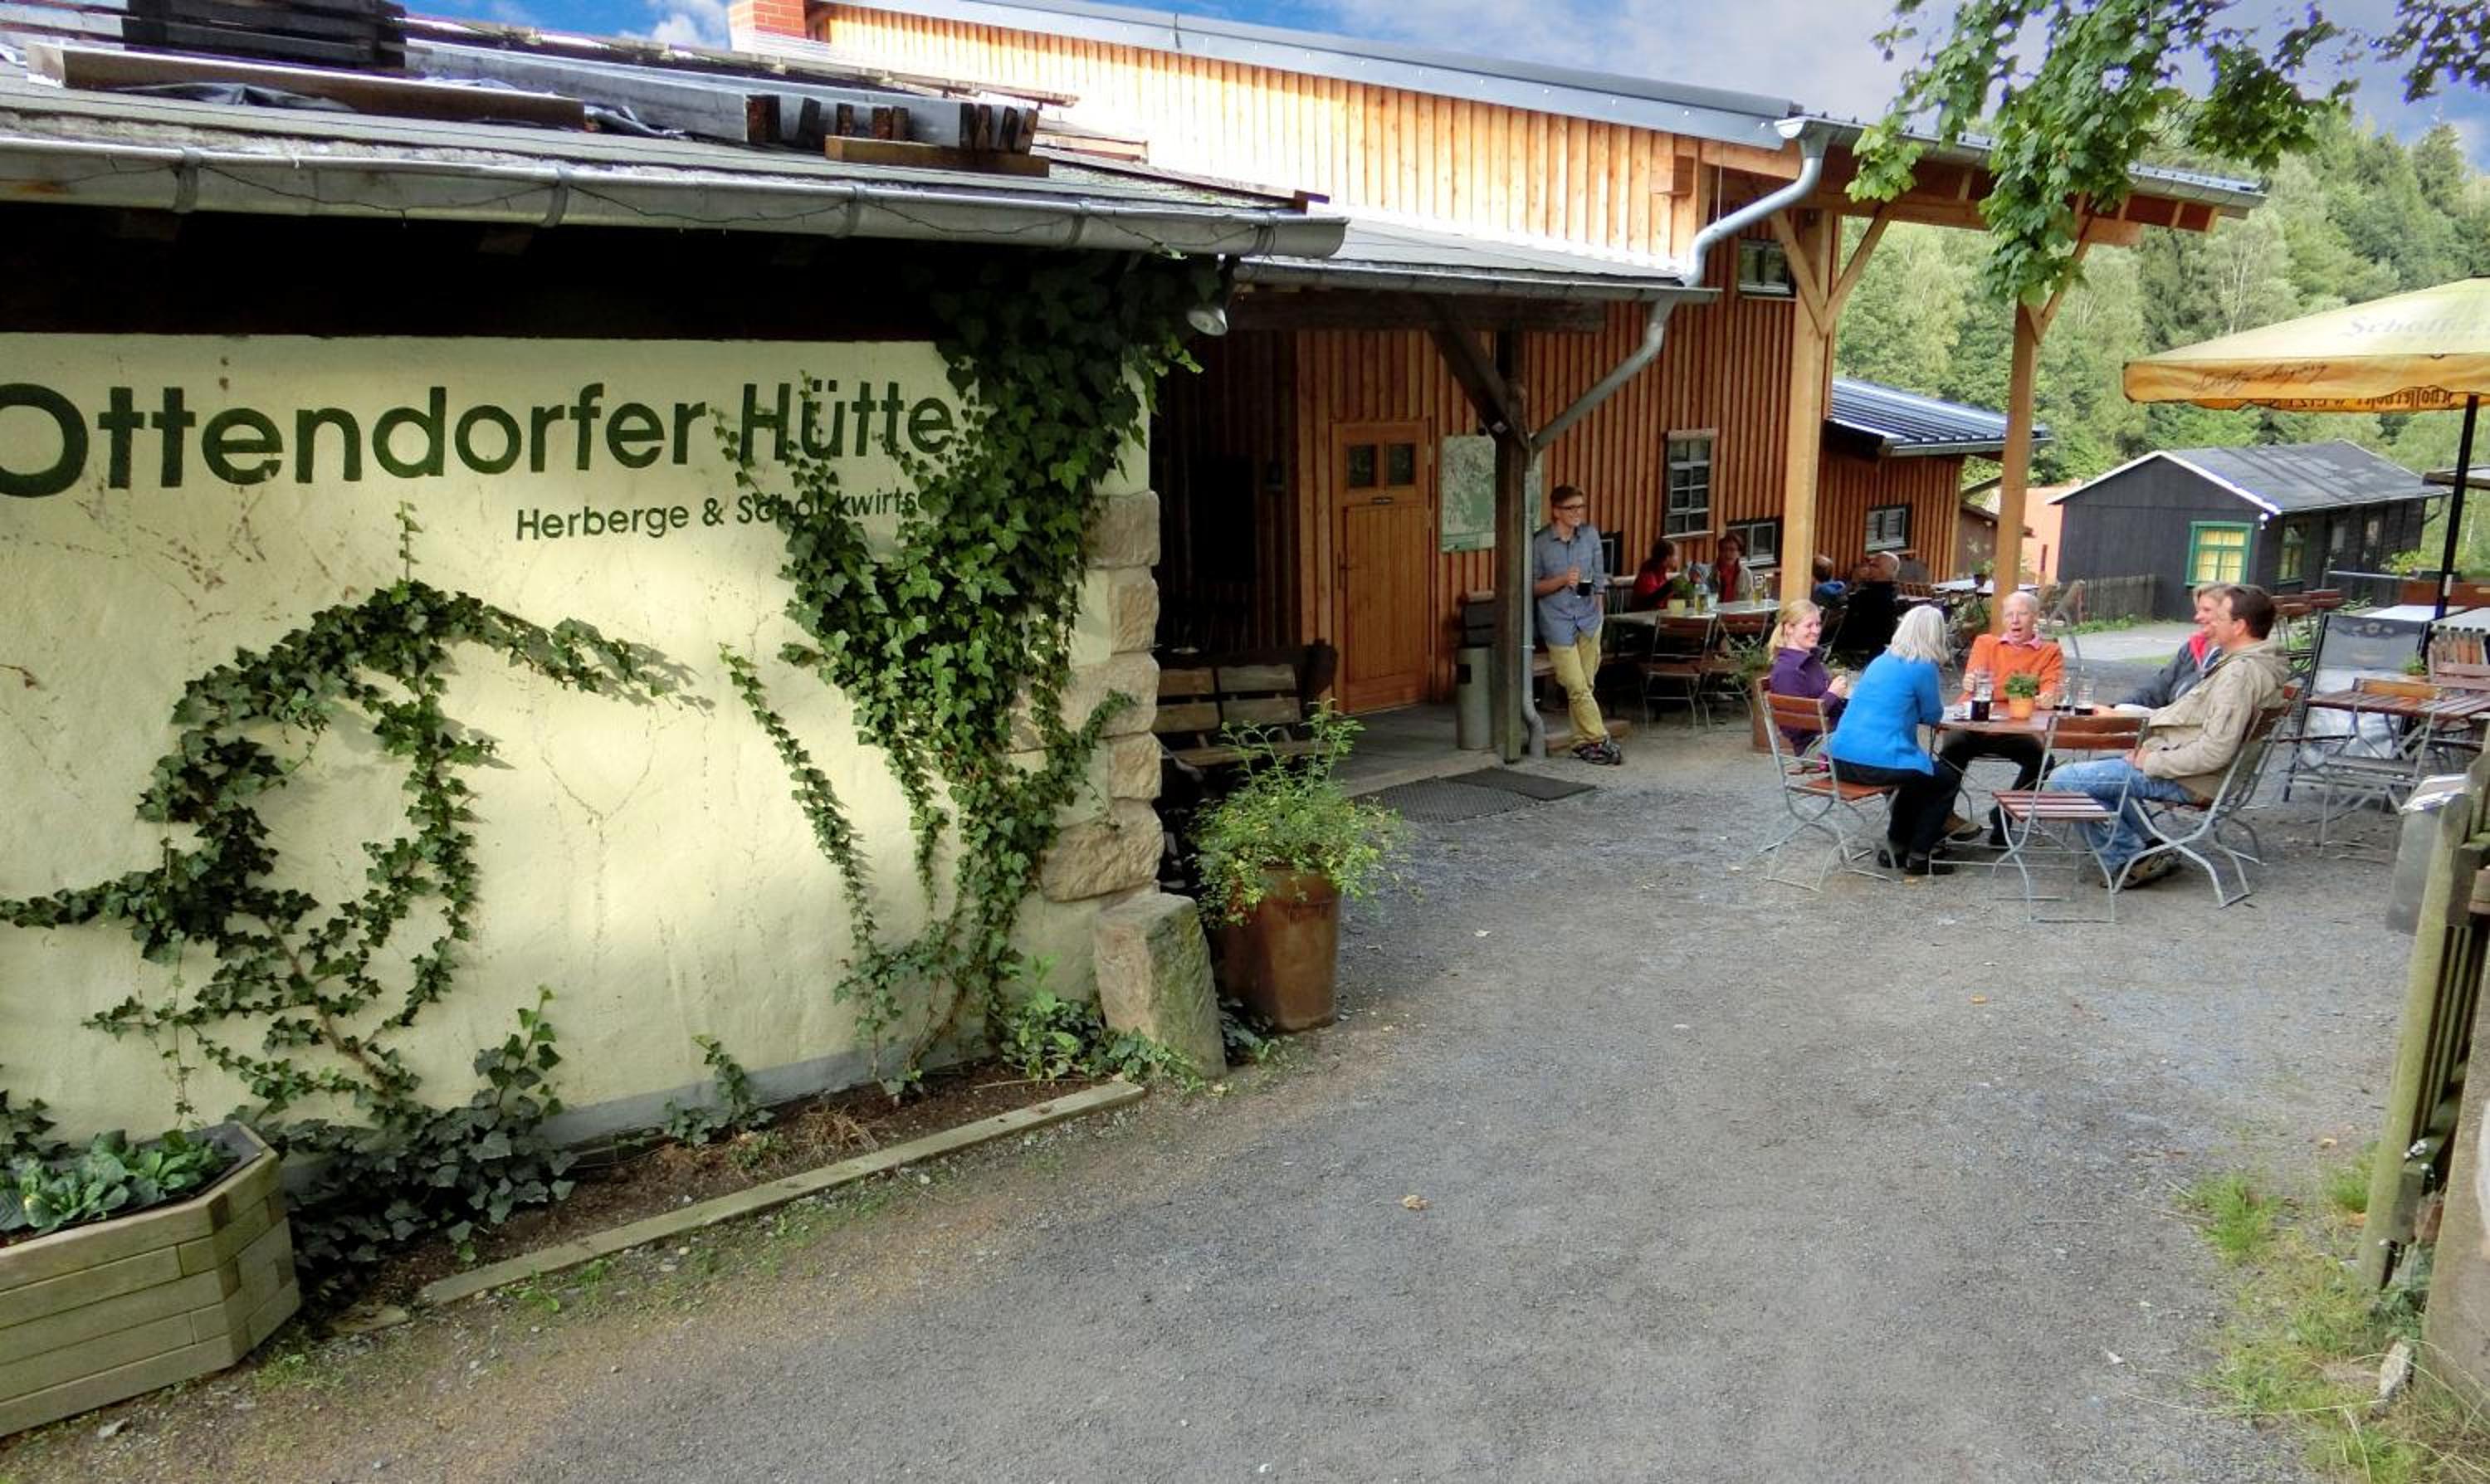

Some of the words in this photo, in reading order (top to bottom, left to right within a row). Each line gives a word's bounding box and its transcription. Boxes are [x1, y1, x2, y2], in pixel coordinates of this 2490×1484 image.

[0, 383, 706, 498] Ottendorfer
[740, 379, 953, 461] Hütte
[516, 505, 690, 540] Herberge
[702, 497, 724, 527] &
